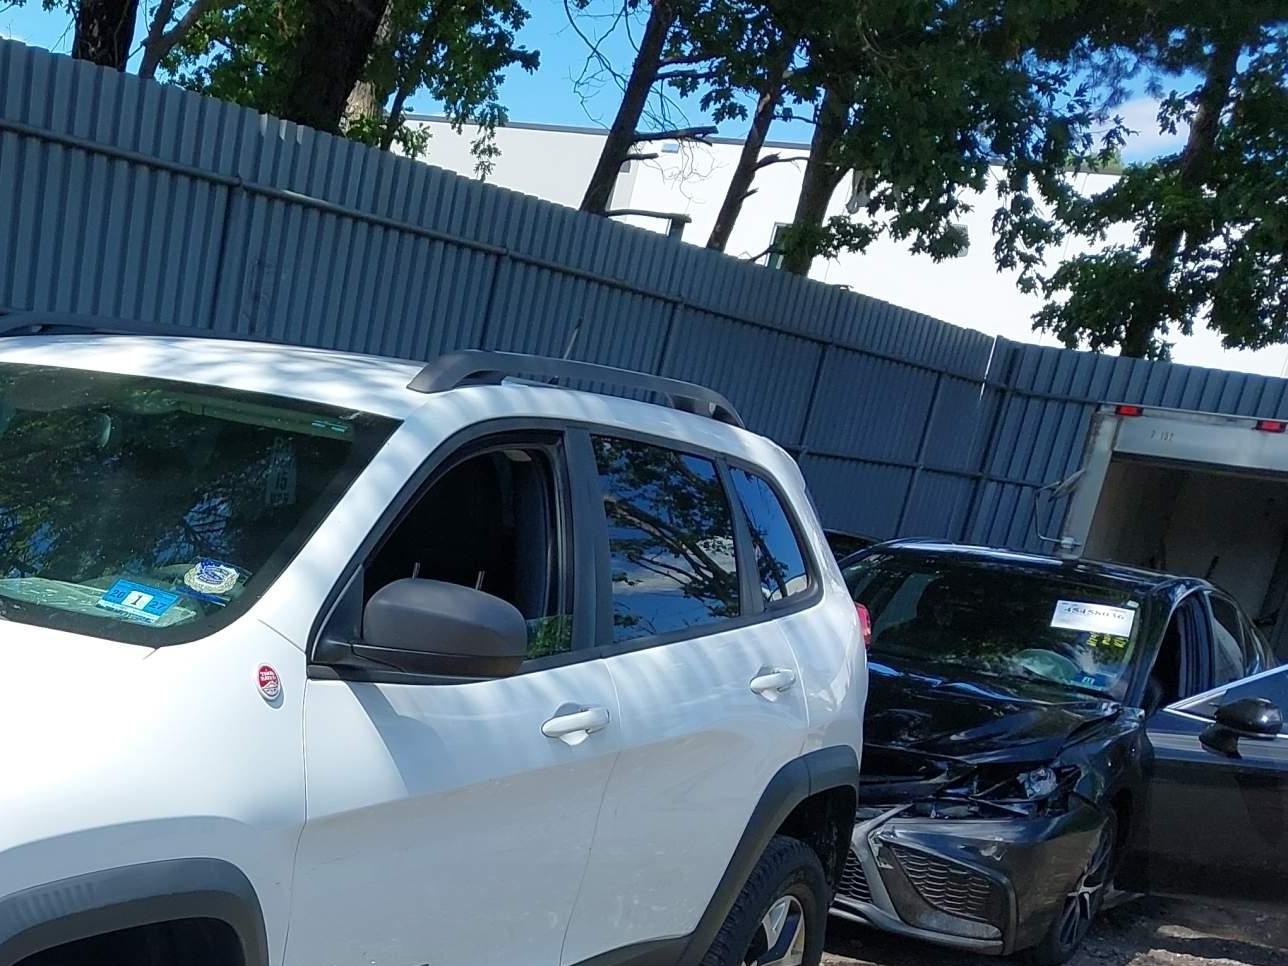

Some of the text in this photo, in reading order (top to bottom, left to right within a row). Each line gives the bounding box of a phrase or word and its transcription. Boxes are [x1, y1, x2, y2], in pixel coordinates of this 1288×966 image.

[110, 589, 163, 610] 20 1 27
